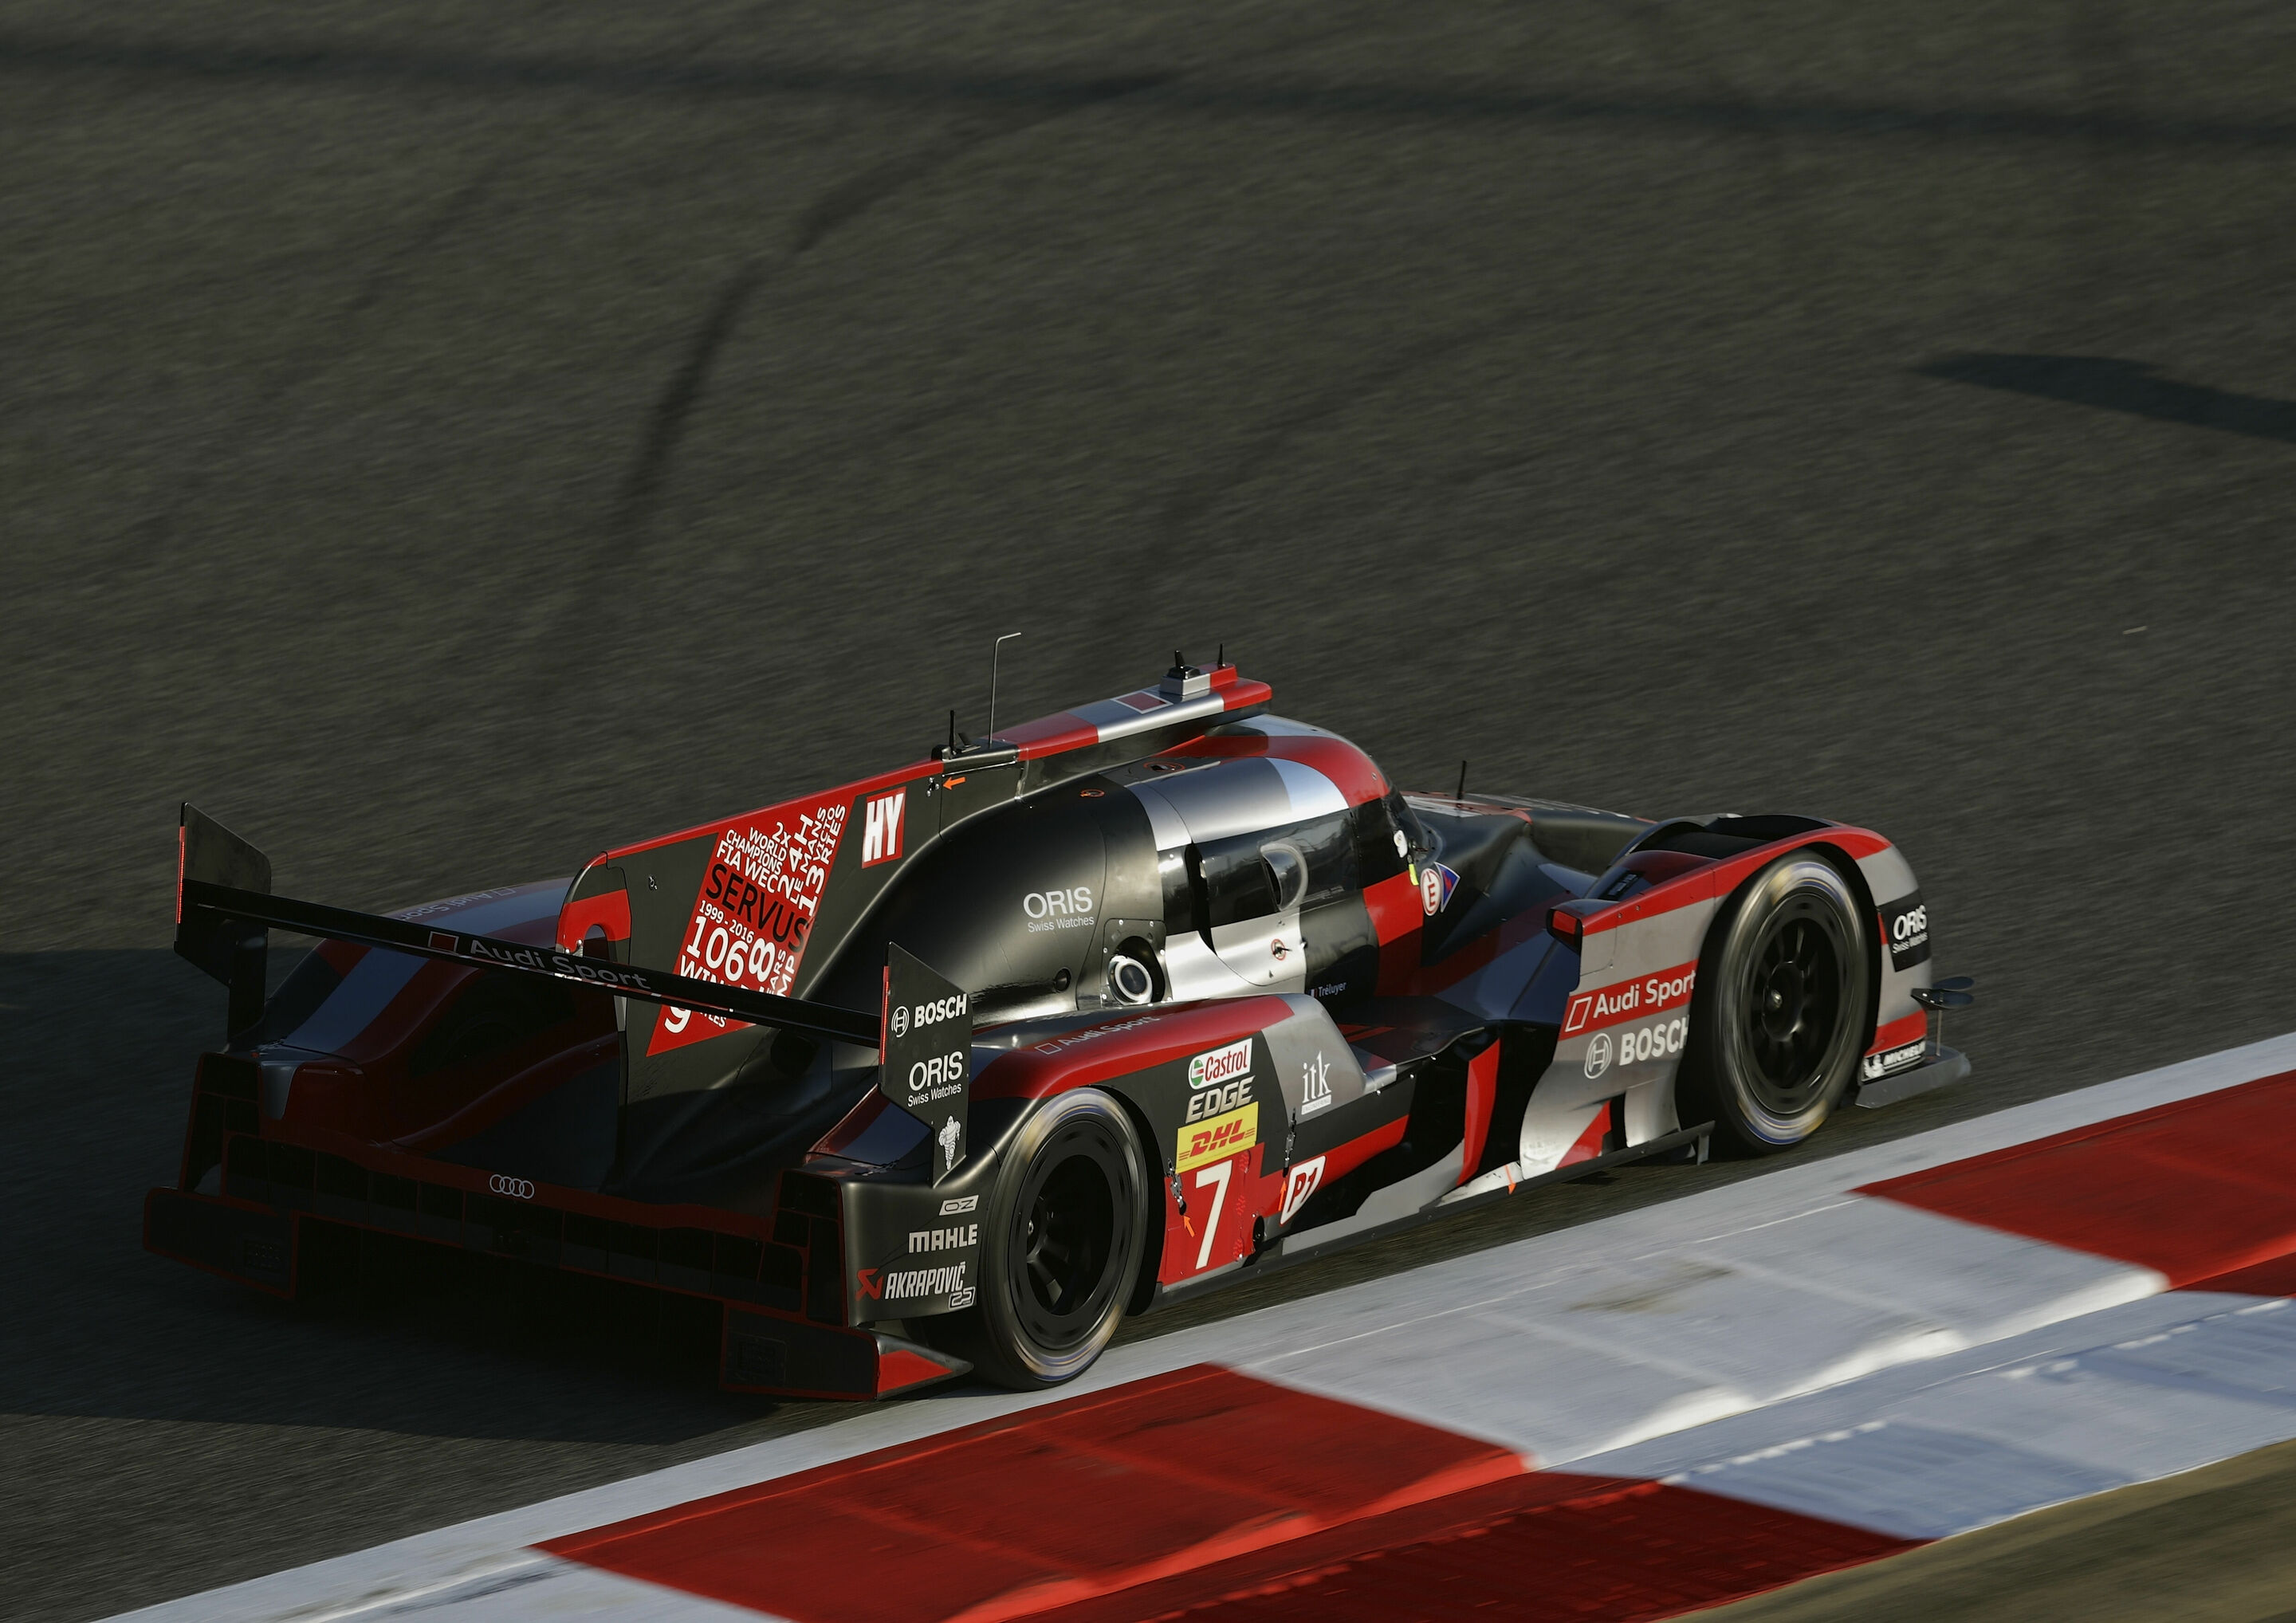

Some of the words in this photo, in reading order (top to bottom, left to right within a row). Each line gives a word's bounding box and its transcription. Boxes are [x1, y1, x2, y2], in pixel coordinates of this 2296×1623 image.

[749, 827, 787, 862] WORLD
[863, 792, 905, 863] HY
[717, 840, 741, 871] FIA
[745, 857, 779, 893] WEC
[726, 829, 783, 875] CHAMPIONS
[790, 878, 804, 904] LE
[800, 807, 826, 874] MANS
[397, 905, 450, 921] Spor
[706, 863, 810, 953] SERVUS
[798, 865, 824, 917] 13
[1023, 886, 1092, 918] ORIS
[699, 900, 724, 924] 1999
[729, 919, 754, 944] 2016
[1028, 921, 1055, 933] Swiss
[1056, 917, 1094, 930] Watches
[1893, 905, 1927, 940] ORIS
[470, 939, 545, 969] Audi
[552, 956, 651, 990] Sport
[686, 915, 749, 981] 106
[914, 993, 967, 1028] BOSCH
[1593, 984, 1639, 1019] Audi
[1645, 969, 1696, 1007] Sport
[1060, 1028, 1105, 1046] Audi
[1103, 1016, 1160, 1034] Sport
[1619, 1014, 1690, 1066] BOSCH
[909, 1051, 963, 1091] ORIS
[1205, 1046, 1248, 1082] Castrol
[1302, 1051, 1331, 1103] itk
[907, 1092, 929, 1107] Swiss
[930, 1083, 961, 1100] Watches
[1185, 1075, 1256, 1124] EDGE
[1190, 1119, 1244, 1157] DHL
[1287, 1167, 1318, 1212] P1
[1196, 1159, 1233, 1270] 7
[908, 1224, 978, 1254] MAHLE
